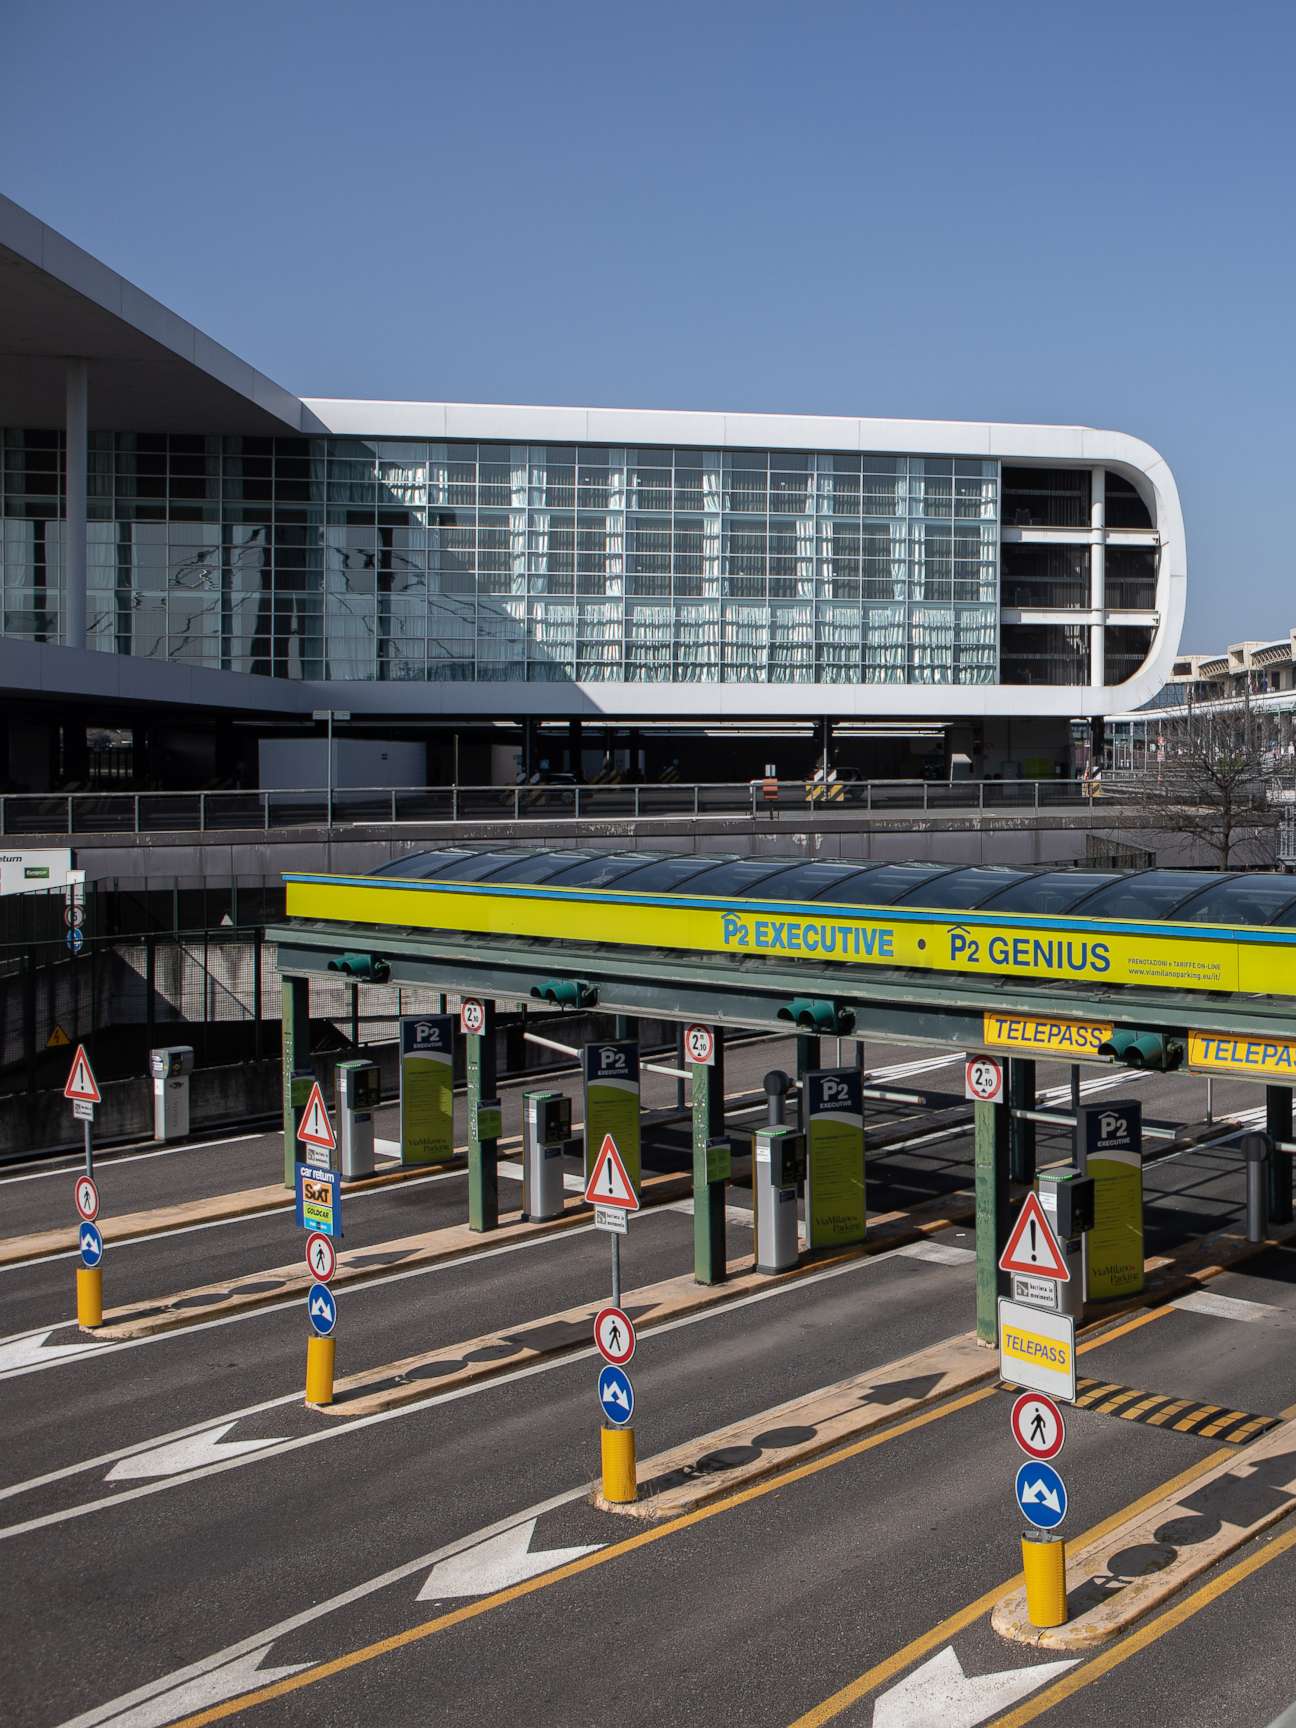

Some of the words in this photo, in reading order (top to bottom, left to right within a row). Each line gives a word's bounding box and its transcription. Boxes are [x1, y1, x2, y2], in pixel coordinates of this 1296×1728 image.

[723, 918, 749, 946] P2
[754, 921, 894, 957] EXECUTIVE
[951, 933, 980, 963] P2
[988, 936, 1111, 973] GENIUS
[416, 1026, 440, 1042] P2
[995, 1019, 1103, 1048] TELEPASS
[601, 1051, 626, 1068] P2
[823, 1082, 849, 1101] P2
[820, 1101, 852, 1109] EXECUTIVE
[1101, 1117, 1128, 1139] P2
[1097, 1138, 1131, 1147] EXECUTIVE
[301, 1167, 312, 1177] car
[313, 1169, 334, 1183] return
[307, 1207, 329, 1219] GOLDCAR
[1030, 1284, 1047, 1293] barriera
[1006, 1334, 1066, 1364] TELEPASS
